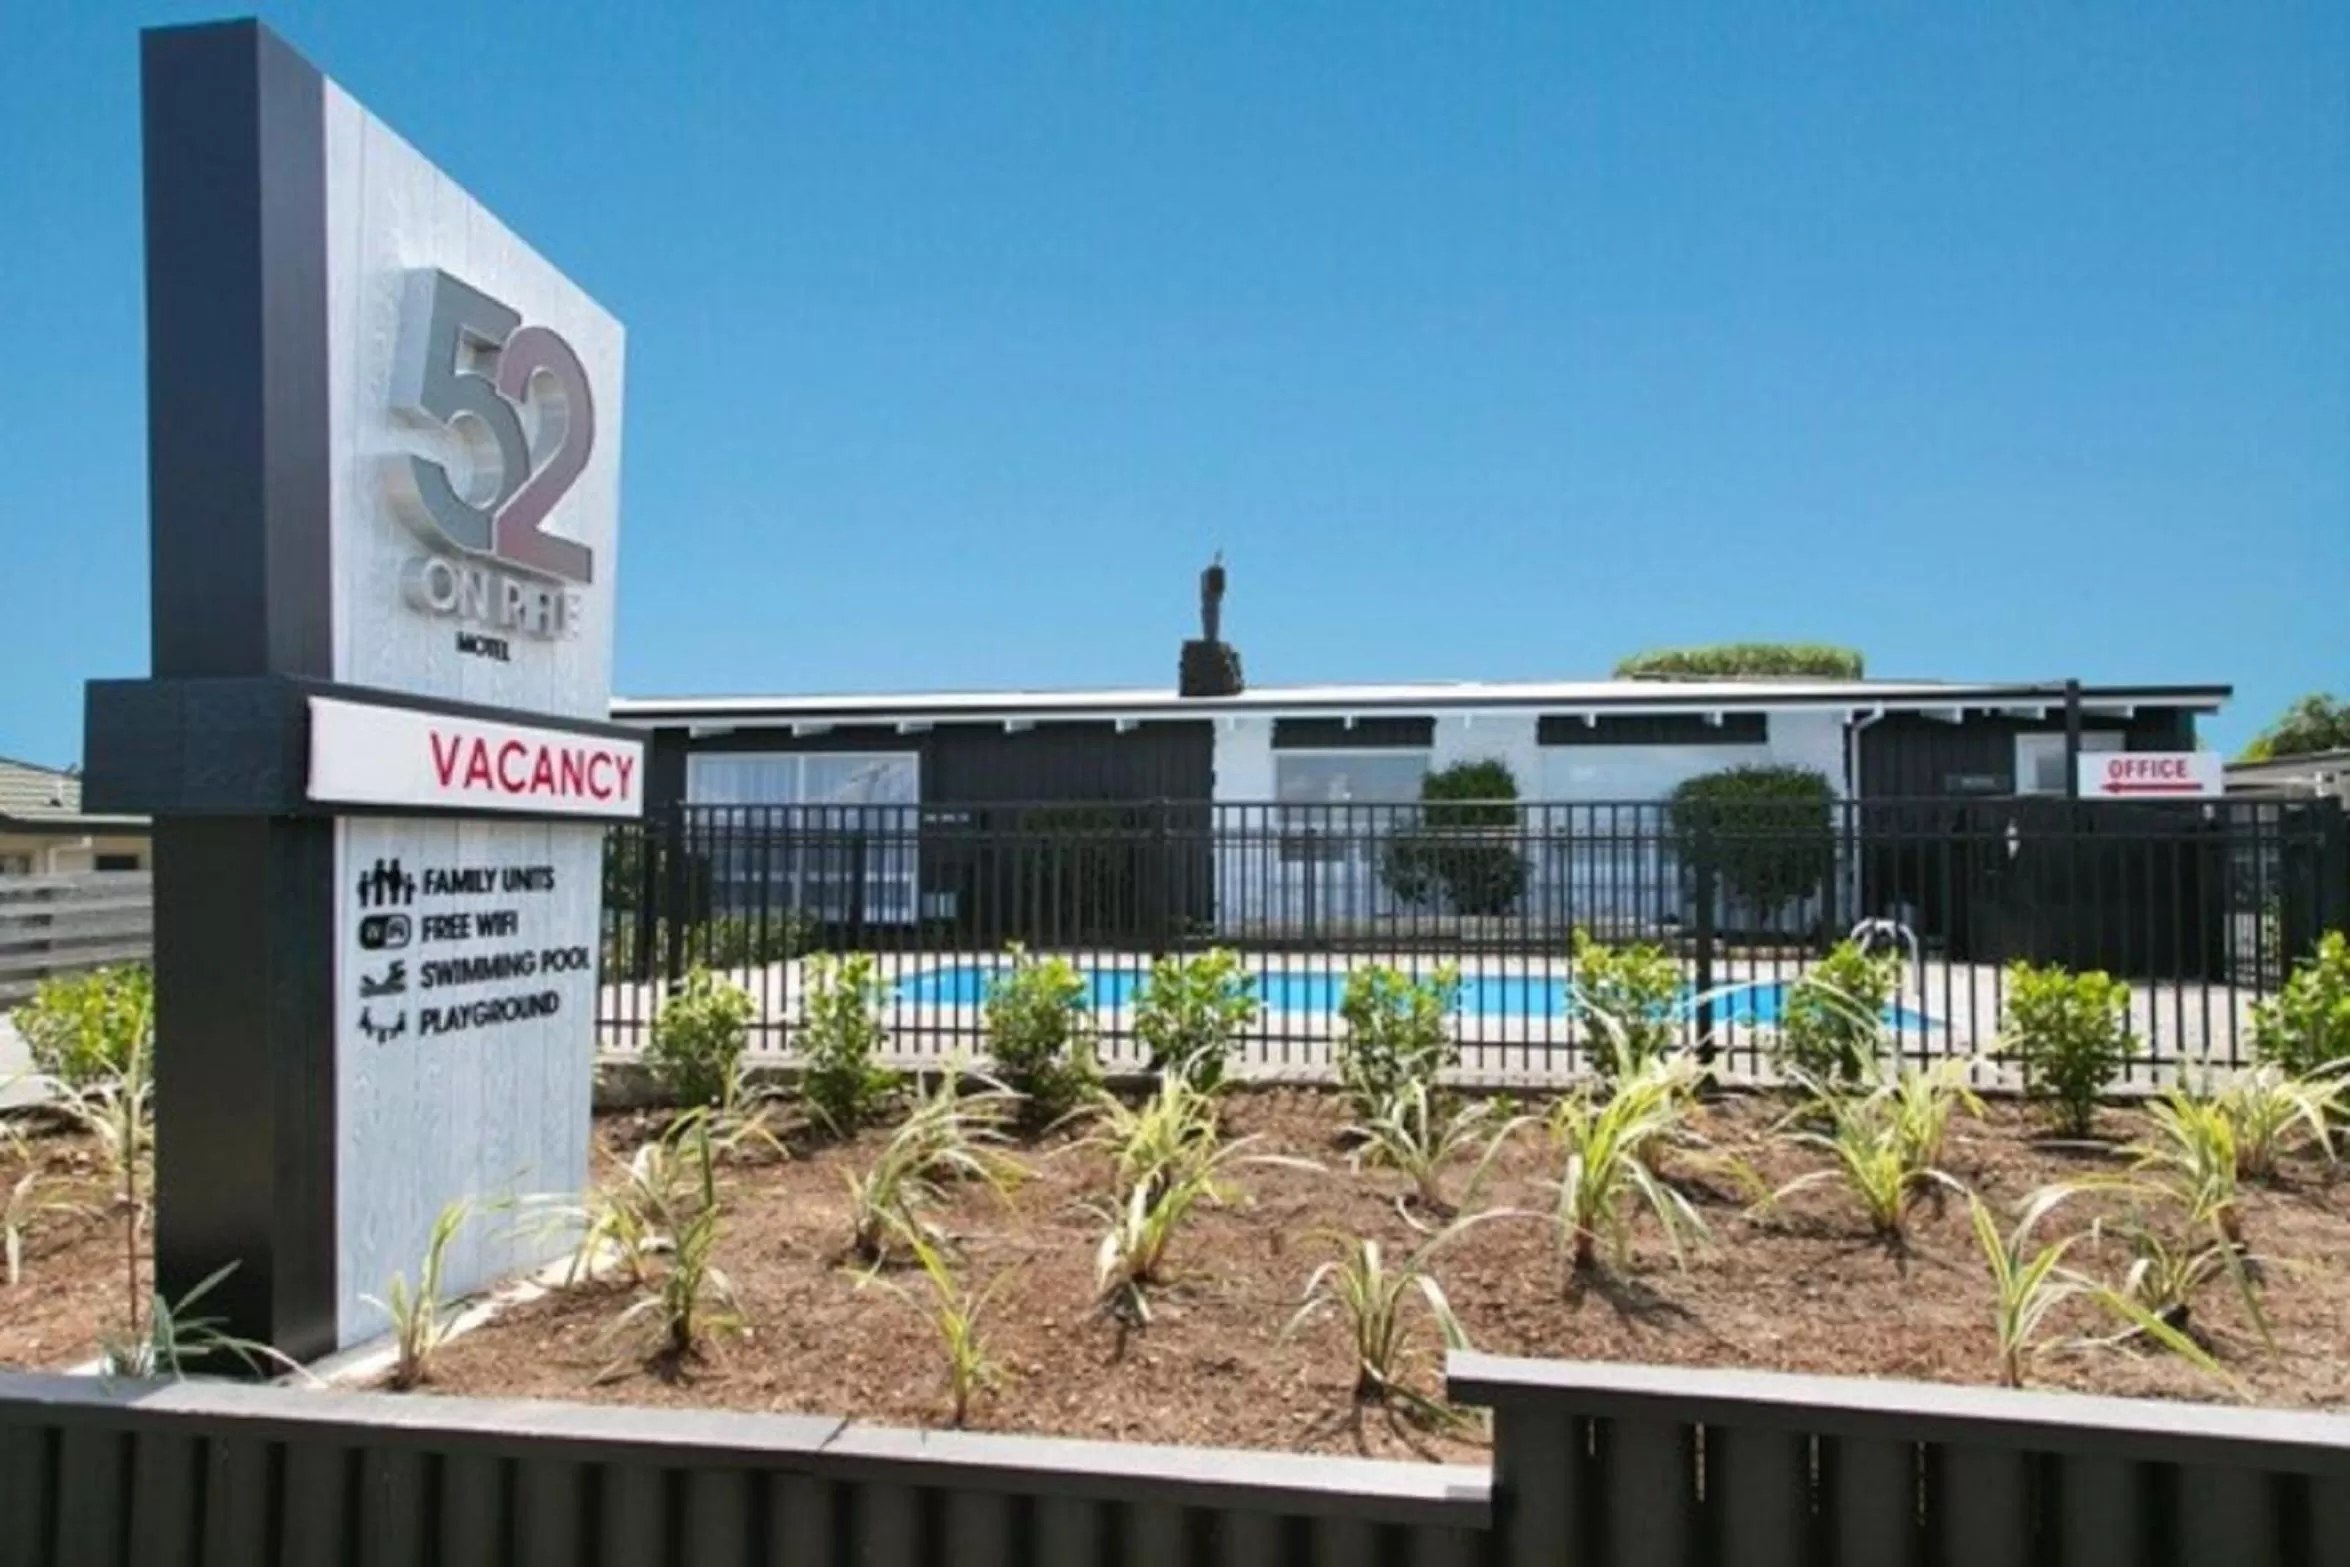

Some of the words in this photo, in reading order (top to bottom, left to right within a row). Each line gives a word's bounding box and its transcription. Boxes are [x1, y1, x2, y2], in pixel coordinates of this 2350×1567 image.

[400, 267, 594, 584] 52
[422, 556, 490, 622] ON
[430, 731, 634, 799] VACANCY
[2108, 758, 2189, 779] OFFICE
[422, 867, 497, 895] FAMILY
[502, 865, 555, 893] UNITS
[421, 913, 471, 942] FREE
[475, 910, 519, 938] WIFI
[420, 950, 537, 988] SWIMMING
[540, 946, 590, 974] POOL
[419, 990, 559, 1036] PLAYGROUND
